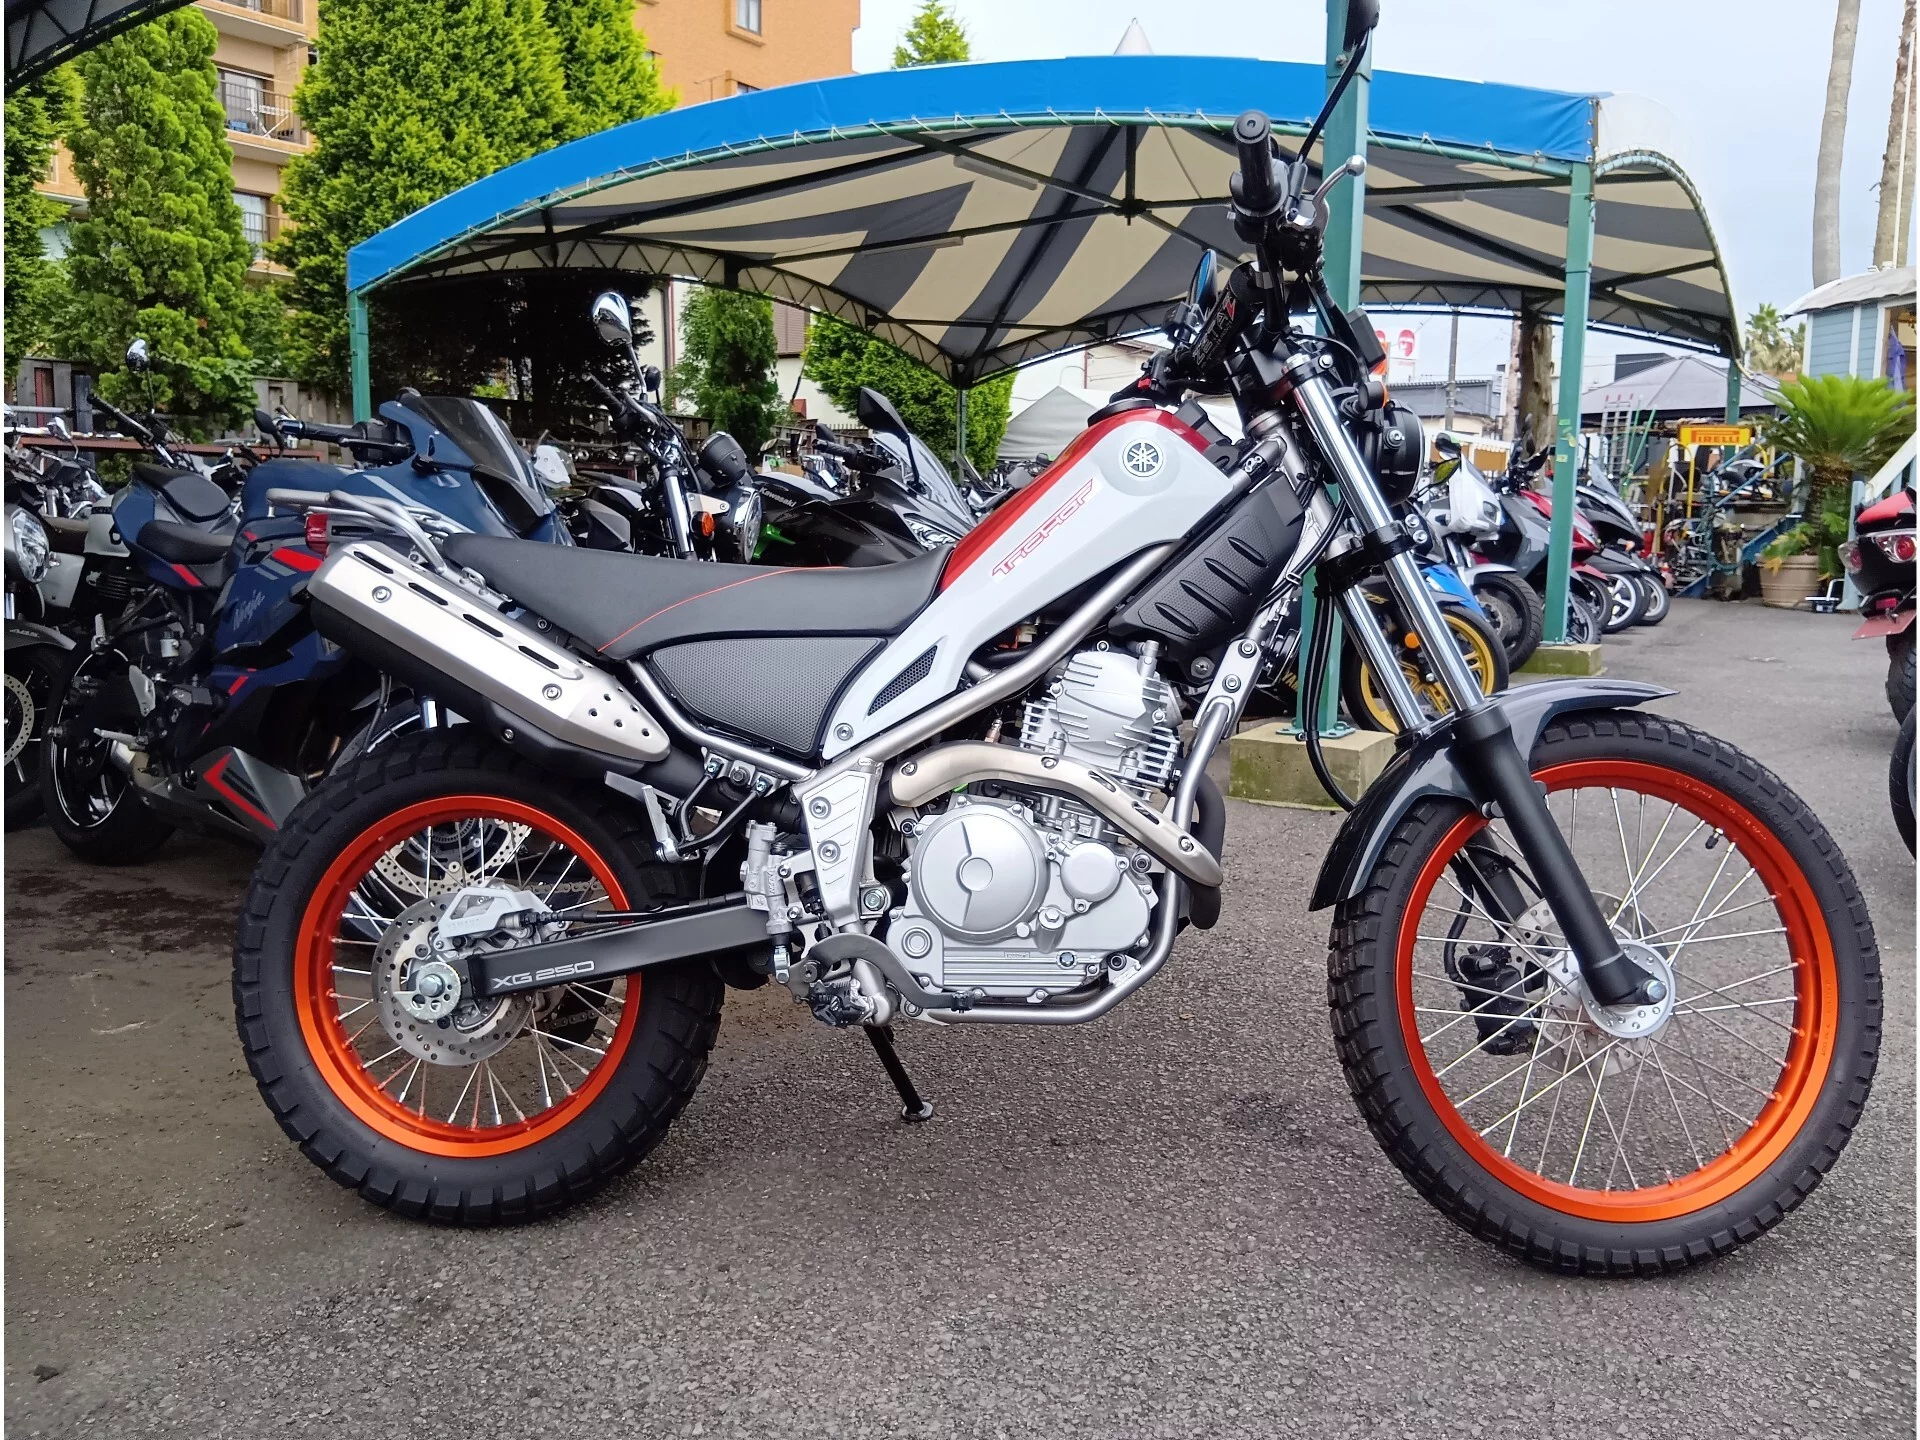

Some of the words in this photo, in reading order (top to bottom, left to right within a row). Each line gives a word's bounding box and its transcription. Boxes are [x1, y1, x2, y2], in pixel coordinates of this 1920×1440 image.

[1691, 429, 1740, 443] PIRELLI
[759, 486, 797, 507] Kawasaki
[492, 972, 533, 989] XG
[535, 960, 595, 981] 250
